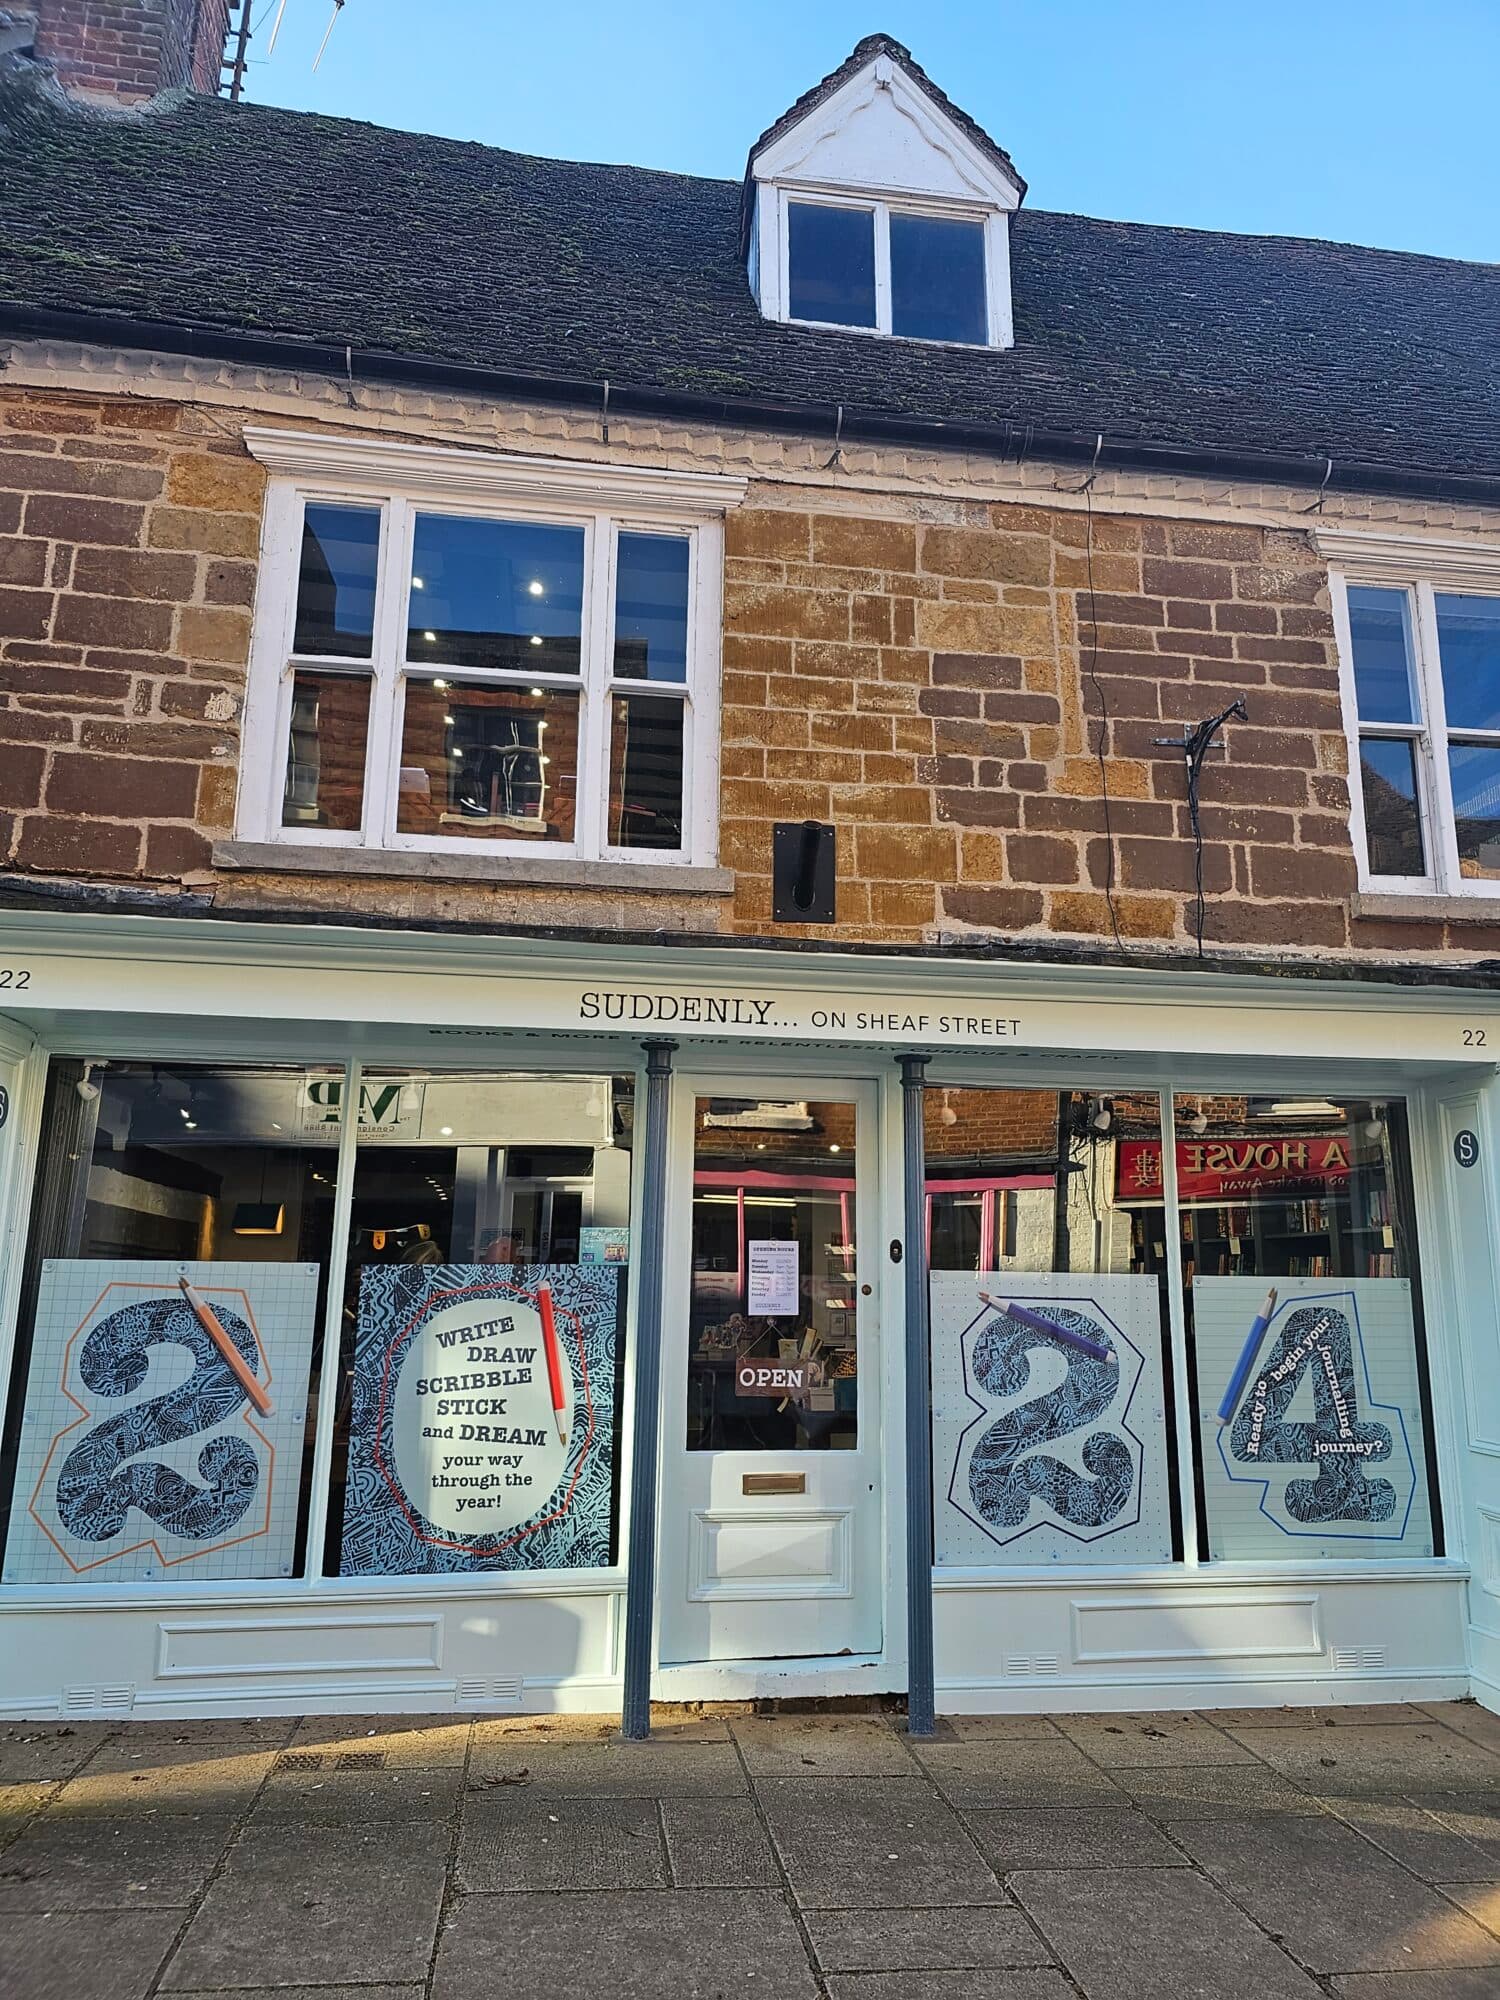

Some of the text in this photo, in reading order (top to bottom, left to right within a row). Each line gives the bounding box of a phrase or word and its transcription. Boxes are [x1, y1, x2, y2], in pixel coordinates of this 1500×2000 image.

[0, 970, 31, 990] 22
[580, 992, 1022, 1036] SUDDENLY... ON SHEAF STREET
[429, 1029, 514, 1037] BOOKS
[551, 1032, 620, 1040] MORE
[739, 1040, 901, 1052] RELENTLESSLY
[1462, 1029, 1487, 1047] 22
[436, 1316, 515, 1349] WRITE
[467, 1346, 538, 1364] DRAW
[416, 1367, 533, 1396] SCRIBBLE
[740, 1367, 803, 1388] OPEN
[1246, 1315, 1331, 1455] Ready to begin your
[1316, 1342, 1354, 1440] journalling
[436, 1399, 508, 1416] STICK
[422, 1423, 548, 1447] and DREAM
[1312, 1440, 1384, 1456] journey?
[442, 1454, 524, 1470] your way
[431, 1473, 533, 1490] through the
[455, 1494, 502, 1512] year!
